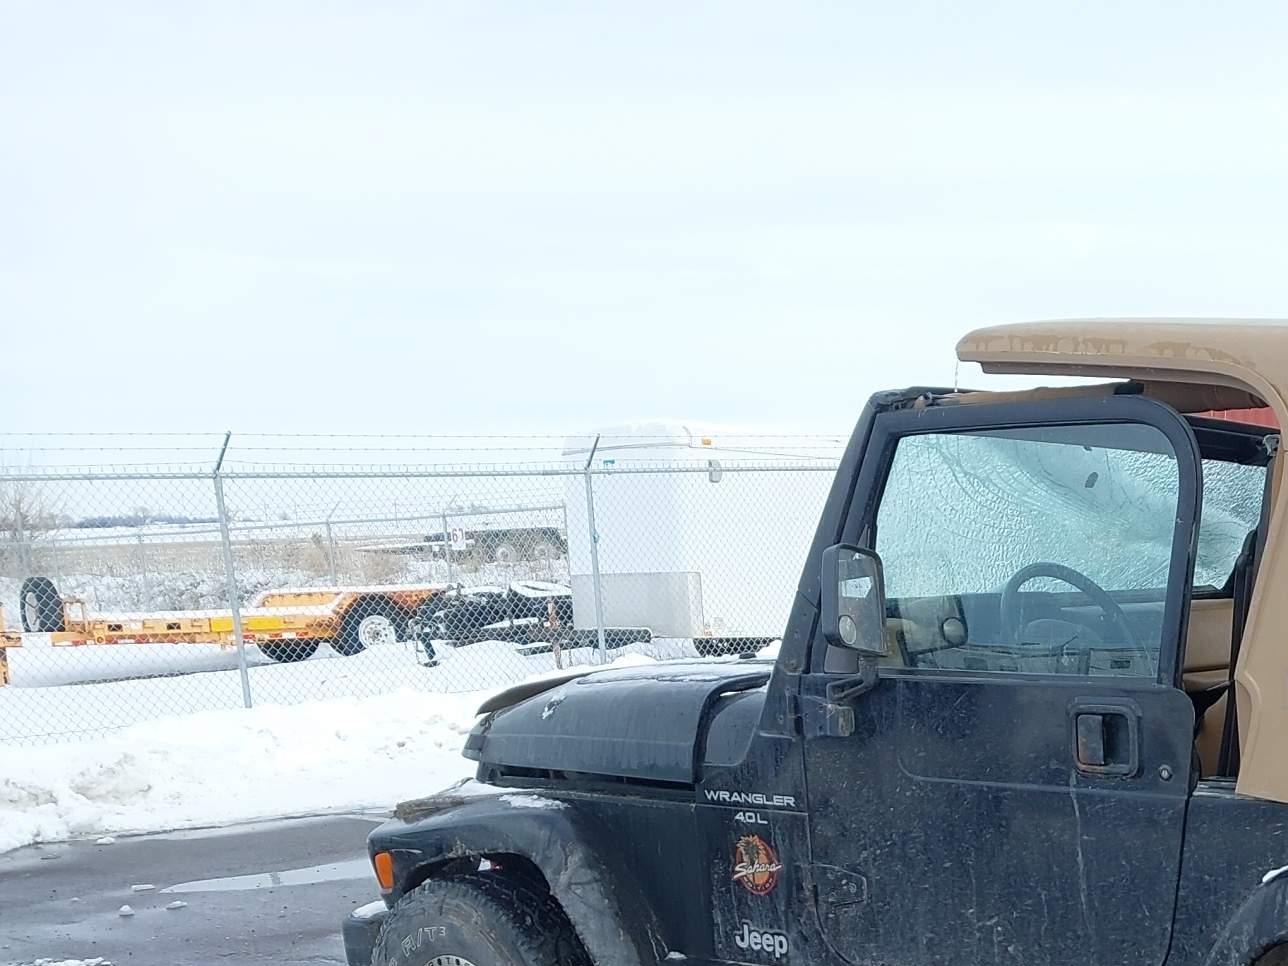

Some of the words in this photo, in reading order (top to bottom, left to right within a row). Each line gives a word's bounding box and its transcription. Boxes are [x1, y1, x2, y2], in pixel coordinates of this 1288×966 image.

[704, 789, 796, 807] WRANGLER
[732, 860, 783, 881] Sahara
[735, 924, 788, 958] Jeep
